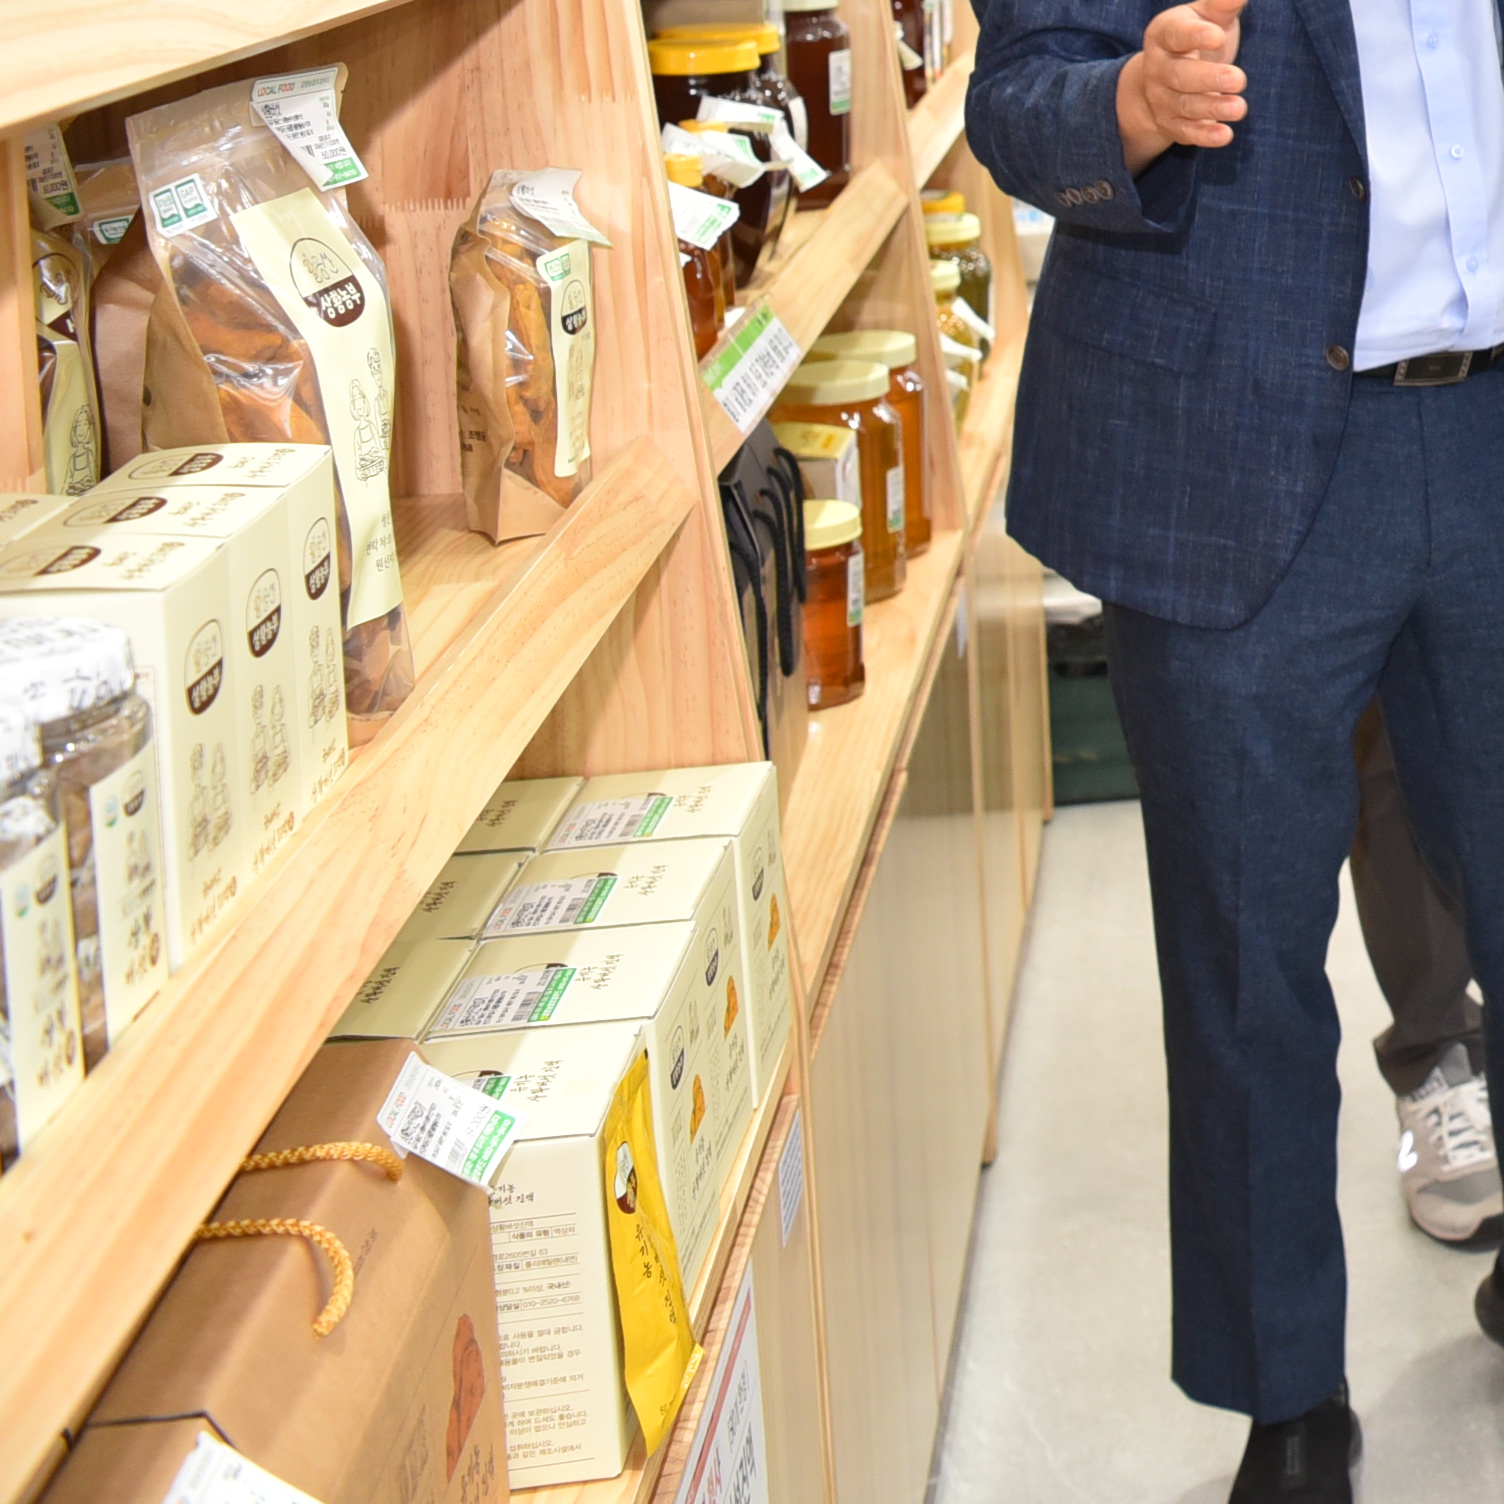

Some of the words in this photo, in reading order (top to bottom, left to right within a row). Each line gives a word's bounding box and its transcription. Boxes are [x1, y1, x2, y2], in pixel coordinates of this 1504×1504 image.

[257, 85, 277, 98] LOCAL
[277, 82, 295, 95] FOOD
[319, 280, 362, 320] 상황농부
[634, 1223, 654, 1280] 유기농
[522, 1294, 581, 1308] 010-2520-6768
